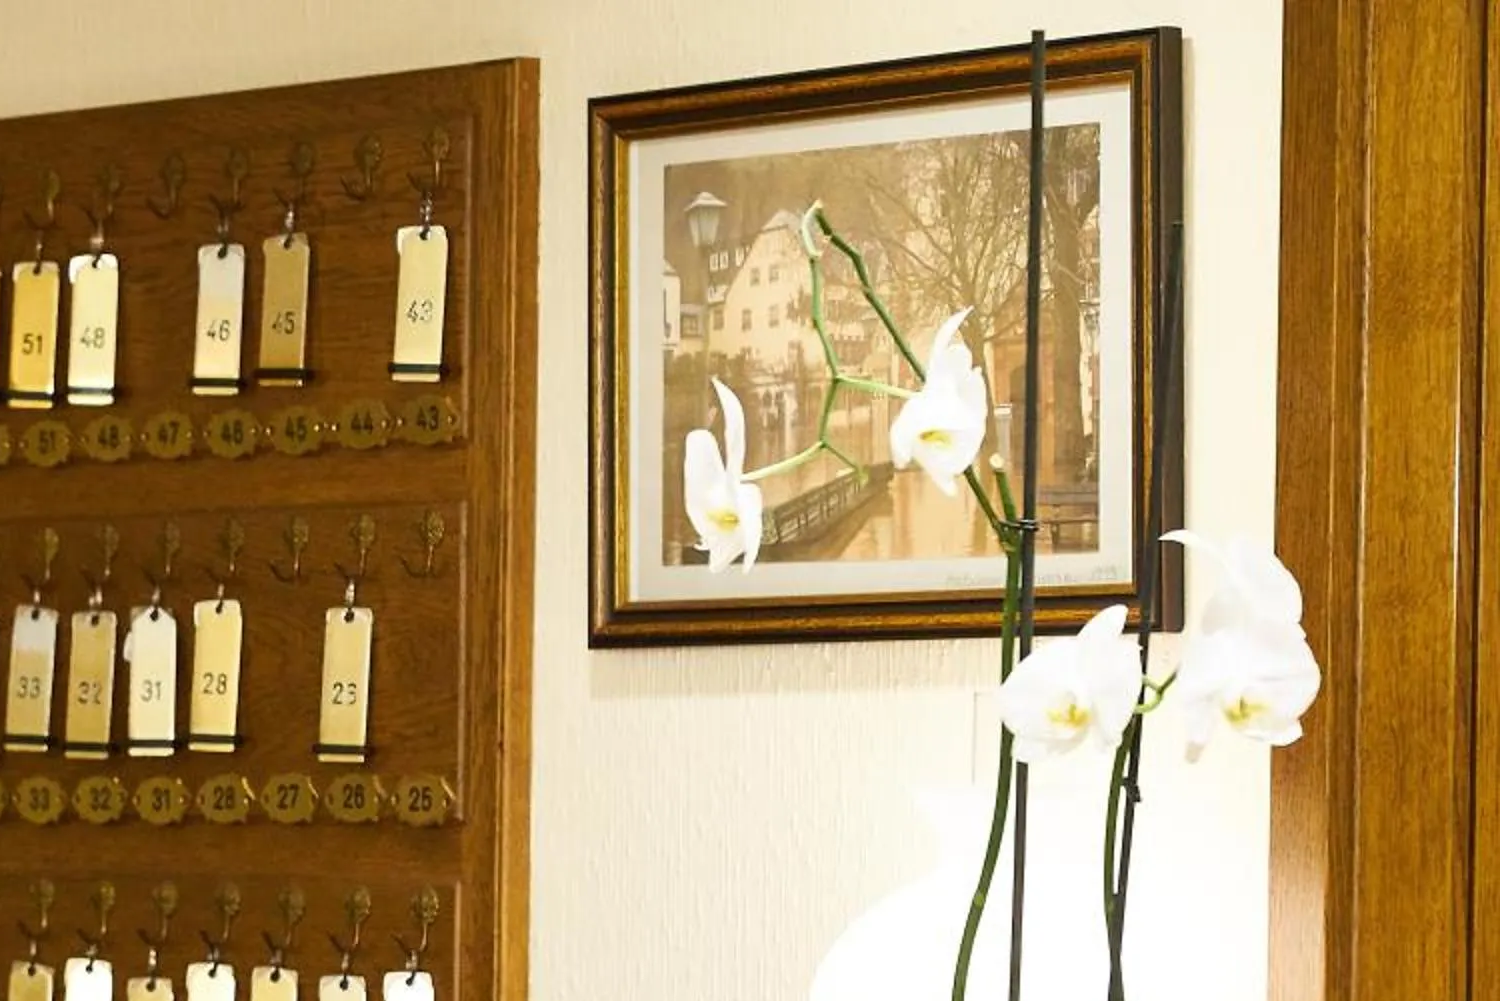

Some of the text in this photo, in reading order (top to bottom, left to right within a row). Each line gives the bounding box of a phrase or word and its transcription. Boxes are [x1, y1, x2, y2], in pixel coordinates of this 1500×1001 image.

[206, 319, 231, 342] 46
[272, 311, 296, 335] 45
[22, 333, 44, 356] 51
[80, 326, 106, 350] 48
[284, 415, 309, 442] 45
[351, 410, 375, 435] 44
[415, 405, 440, 430] 43
[38, 429, 57, 455] 51
[98, 424, 120, 450] 48
[158, 421, 181, 446] 47
[220, 418, 244, 444] 46
[16, 675, 42, 700] 33
[77, 681, 104, 706] 32
[140, 679, 163, 703] 31
[202, 672, 228, 696] 28
[89, 785, 112, 812] 32
[151, 786, 171, 812] 31
[213, 785, 235, 811] 28
[276, 784, 300, 809] 27
[342, 783, 366, 809] 26
[408, 787, 433, 813] 25
